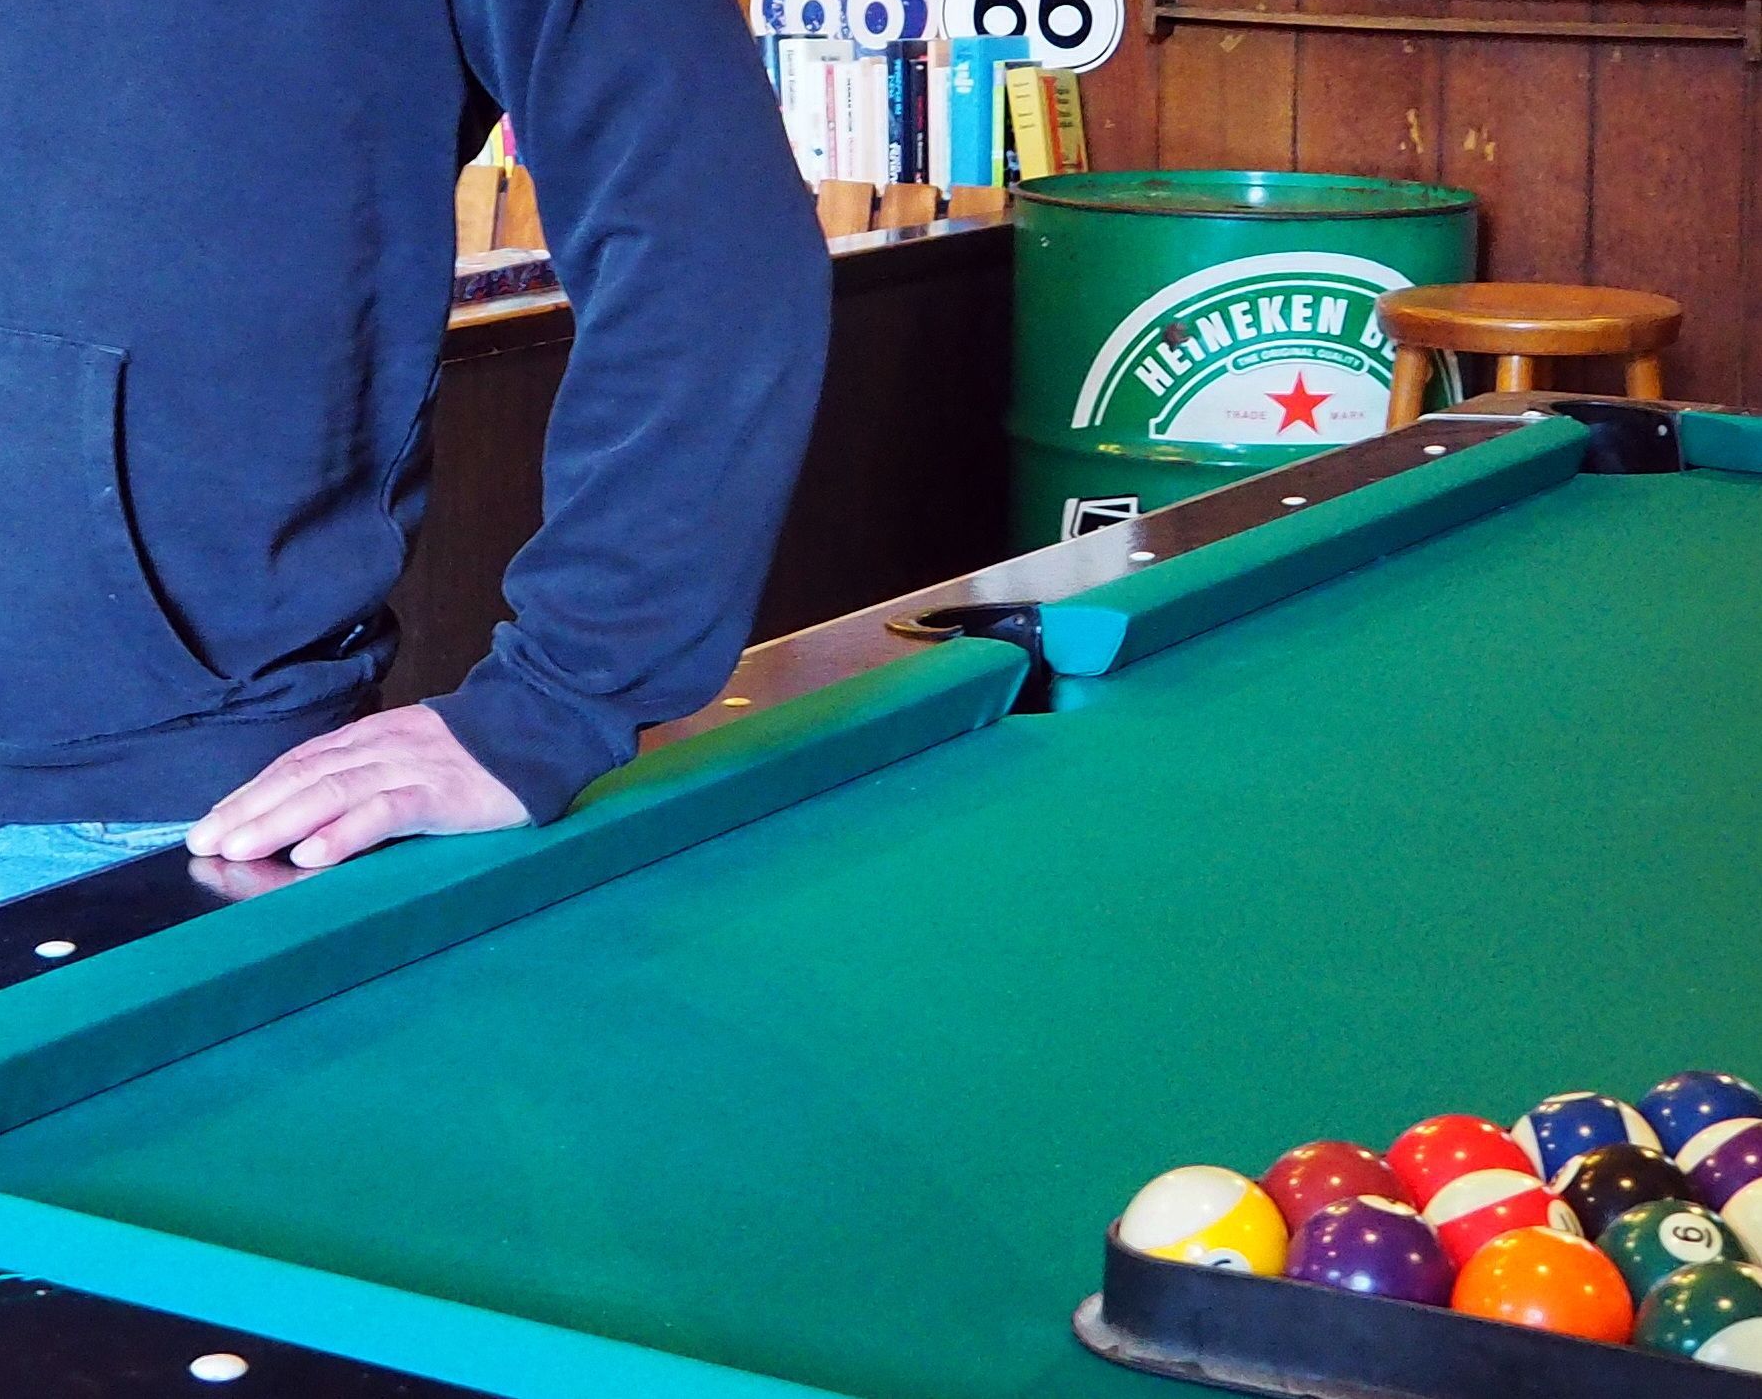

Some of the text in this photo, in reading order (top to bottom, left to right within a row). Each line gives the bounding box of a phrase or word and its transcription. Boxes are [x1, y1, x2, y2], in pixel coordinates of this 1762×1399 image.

[1134, 294, 1349, 398] HEINEKEN
[1226, 409, 1366, 421] TRADE MARK
